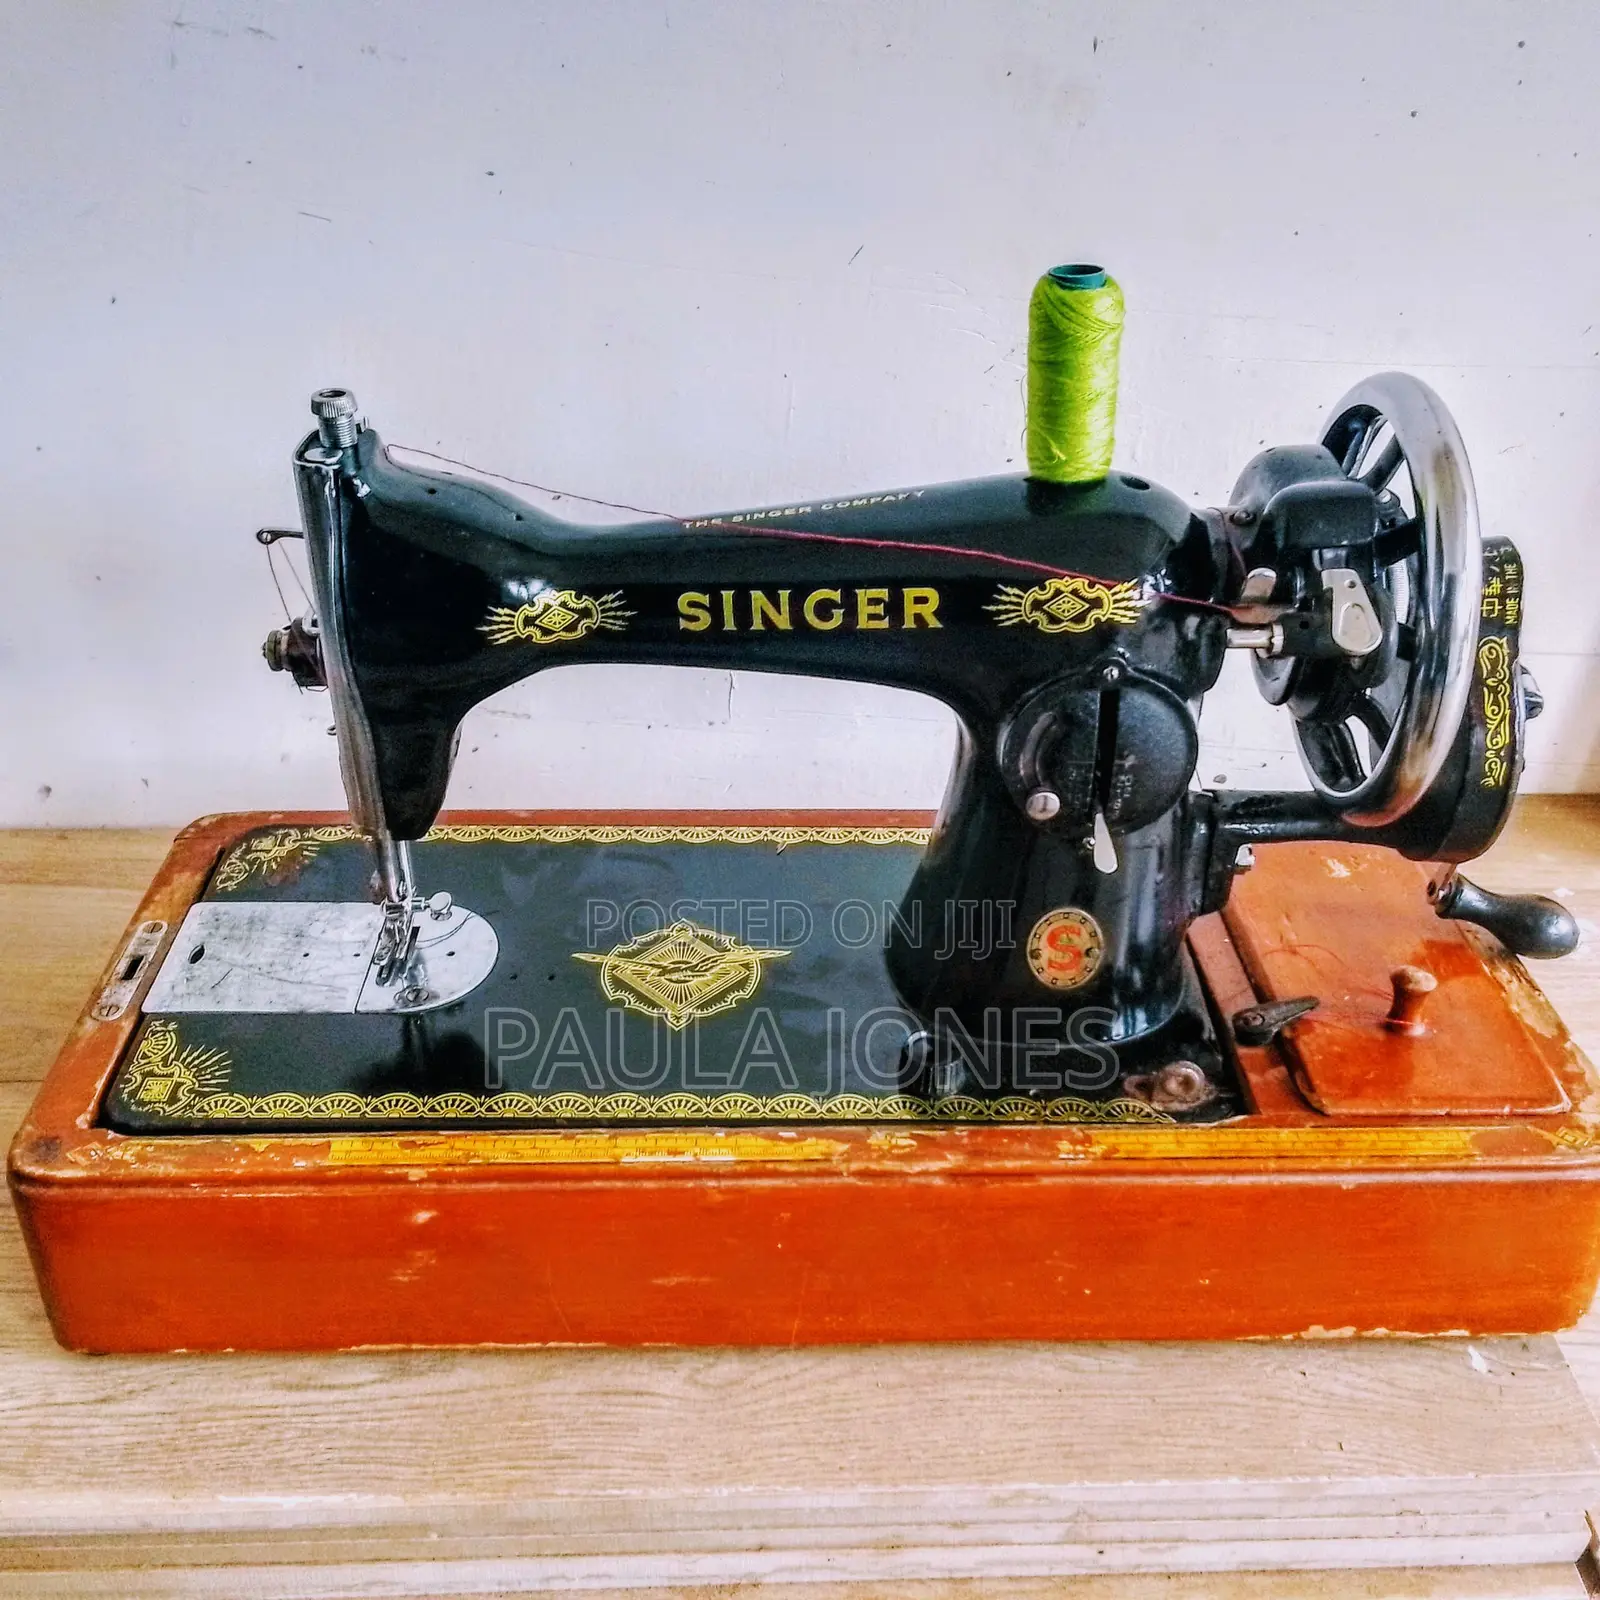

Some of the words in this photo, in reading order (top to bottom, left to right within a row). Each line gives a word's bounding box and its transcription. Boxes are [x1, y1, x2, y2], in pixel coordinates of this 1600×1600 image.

[682, 517, 723, 529] THE
[731, 505, 812, 523] SINGER
[1504, 563, 1518, 580] THE
[677, 587, 944, 632] SINGER
[1505, 597, 1519, 625] MADE
[1047, 925, 1082, 971] S
